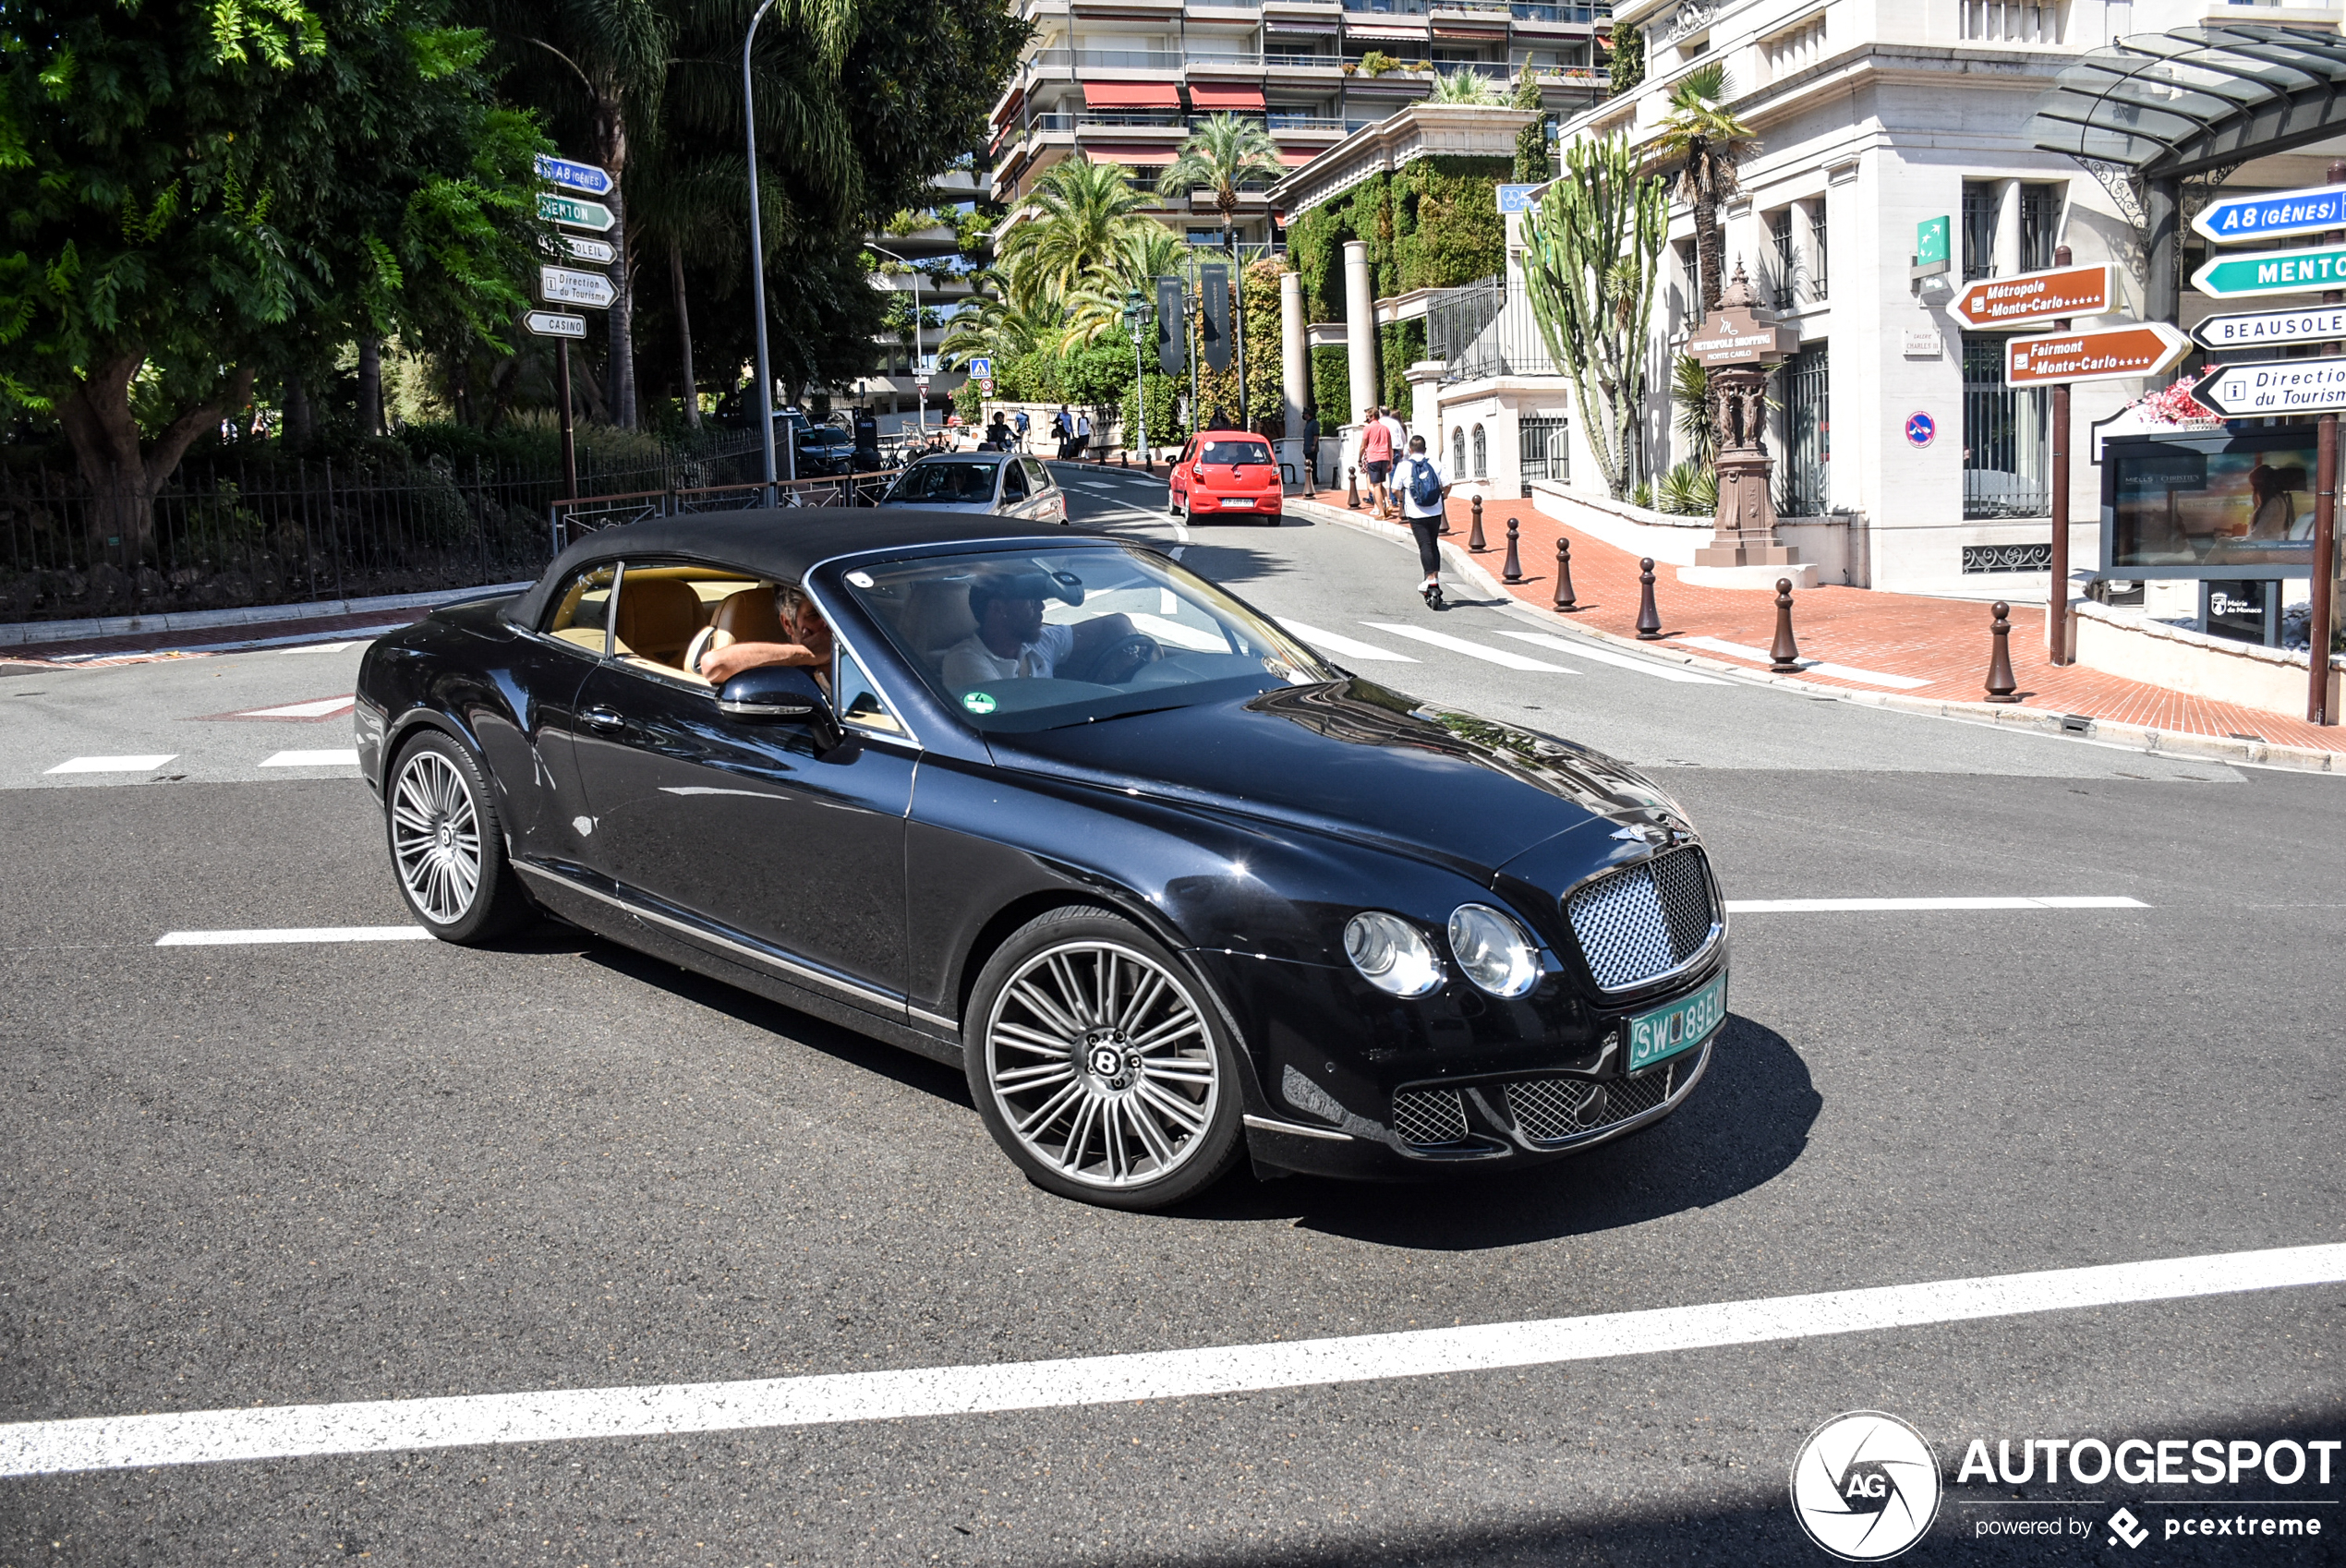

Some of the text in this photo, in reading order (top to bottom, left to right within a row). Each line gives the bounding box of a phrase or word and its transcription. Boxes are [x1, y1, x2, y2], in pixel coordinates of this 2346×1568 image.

[556, 166, 602, 187] A8 (GÊNES)
[2222, 201, 2336, 230] A8 (GÊNES)
[560, 273, 599, 289] Direction
[560, 287, 606, 301] du Tourisme
[1987, 280, 2045, 300] Métropole
[549, 320, 582, 332] CASINO
[2224, 315, 2342, 338] BEAUSOLE
[1693, 334, 1771, 351] METROPOLE SHOPPING
[2030, 340, 2083, 357] Fairmont
[1707, 349, 1751, 360] MONTE CARLO
[2255, 368, 2346, 387] Directio
[2255, 392, 2275, 406] du
[975, 694, 985, 703] 4
[1638, 986, 1718, 1058] SW 89EY
[1095, 1051, 1116, 1074] B
